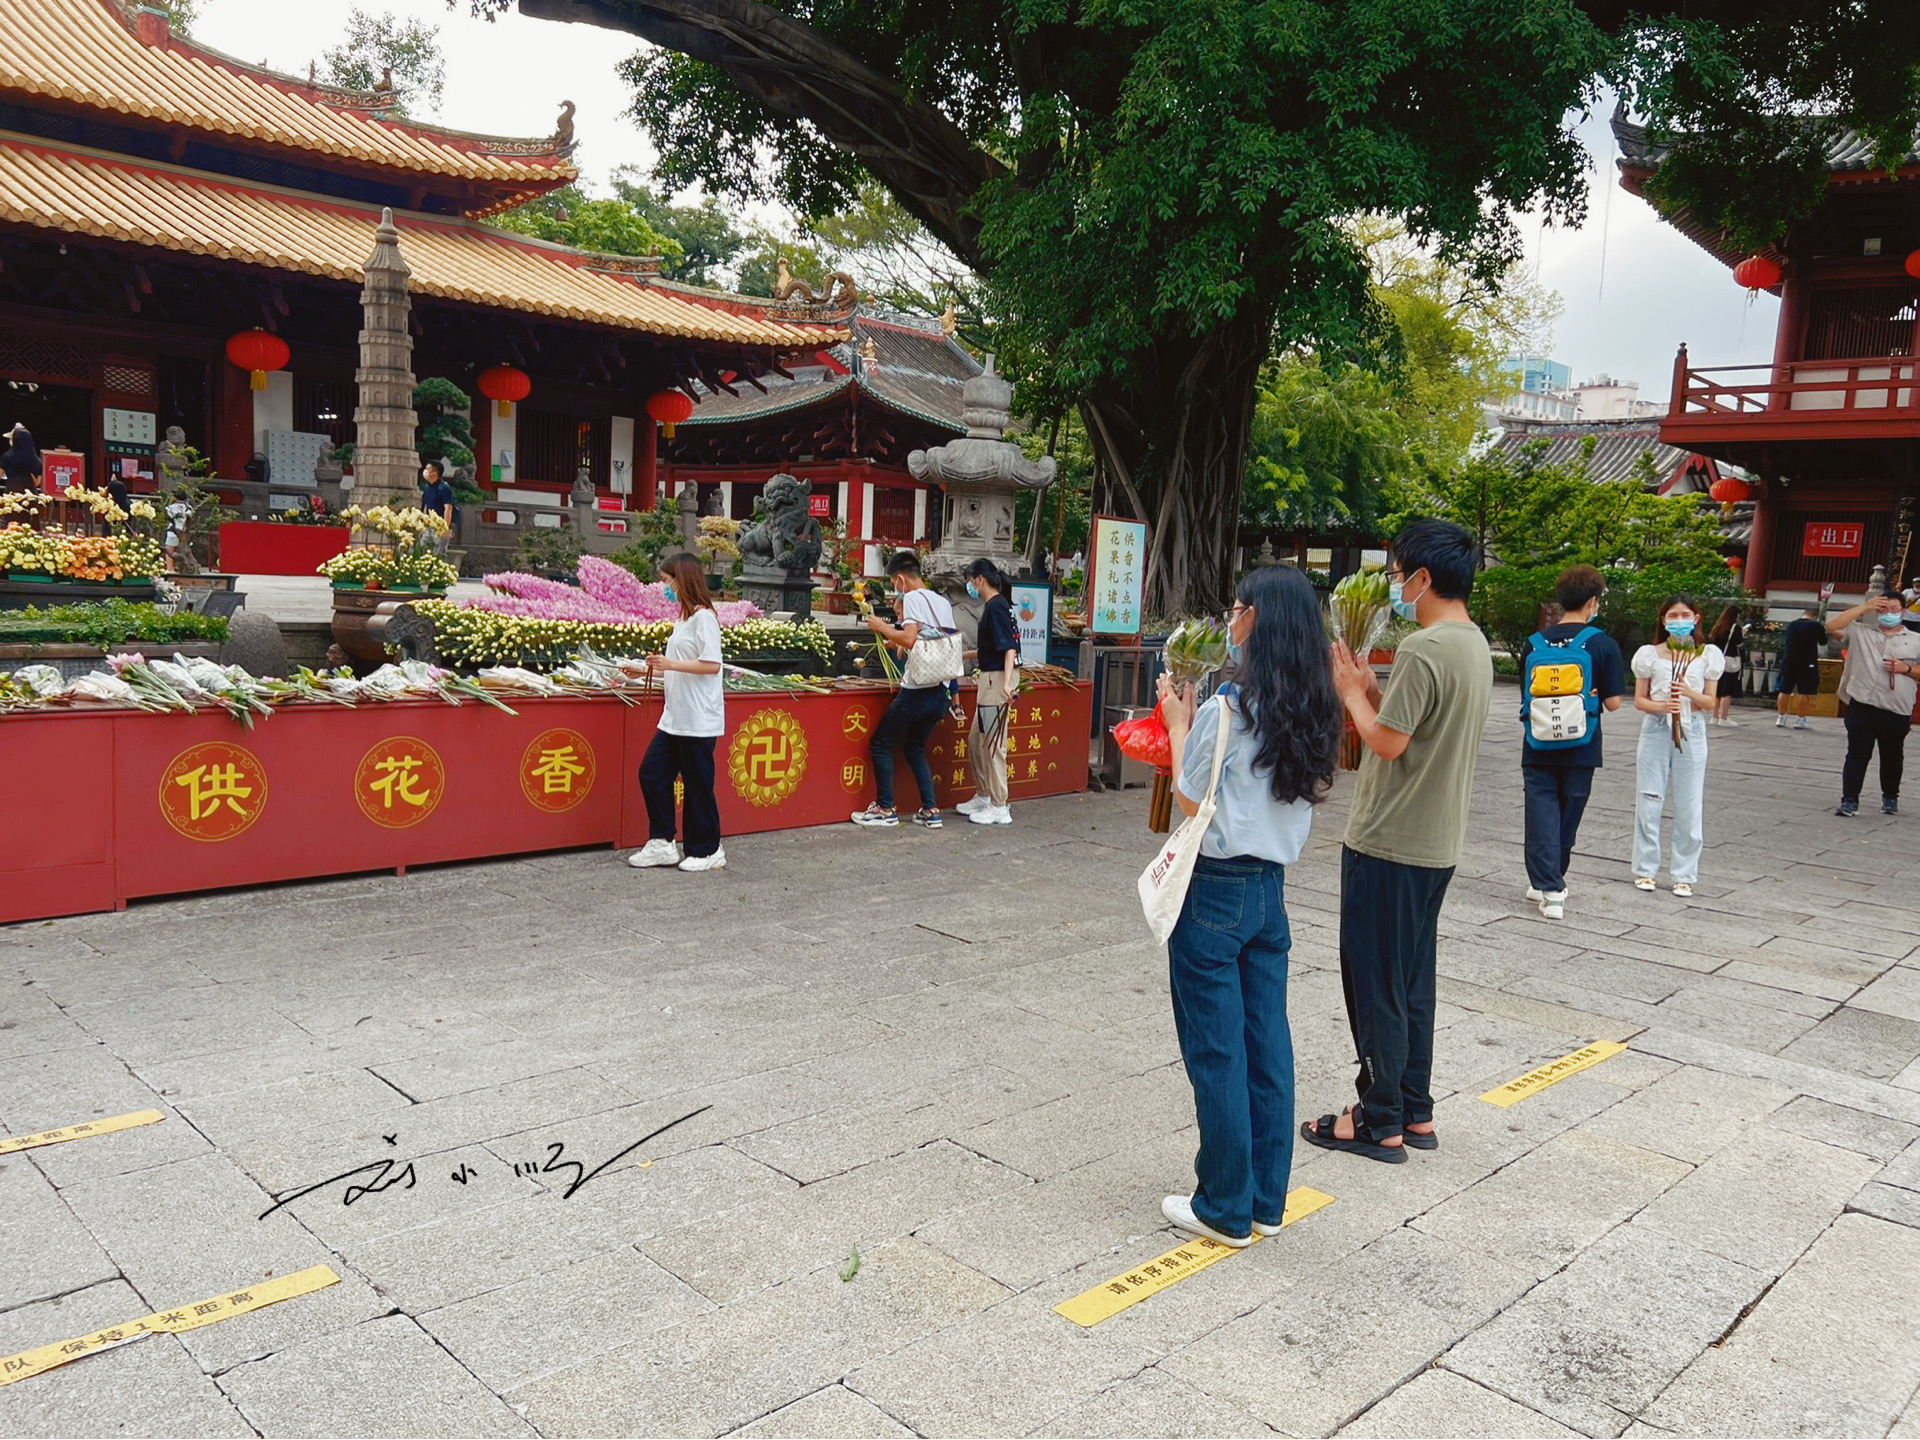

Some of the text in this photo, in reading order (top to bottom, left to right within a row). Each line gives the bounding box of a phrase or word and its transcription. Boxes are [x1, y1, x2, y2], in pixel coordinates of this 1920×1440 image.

[1821, 528, 1857, 543] 出口
[1106, 530, 1120, 624] 花果礼诸佛
[1121, 532, 1134, 625] 供香不点香
[175, 745, 585, 820] 供 花 香
[1105, 1250, 1199, 1295] 请依序排队
